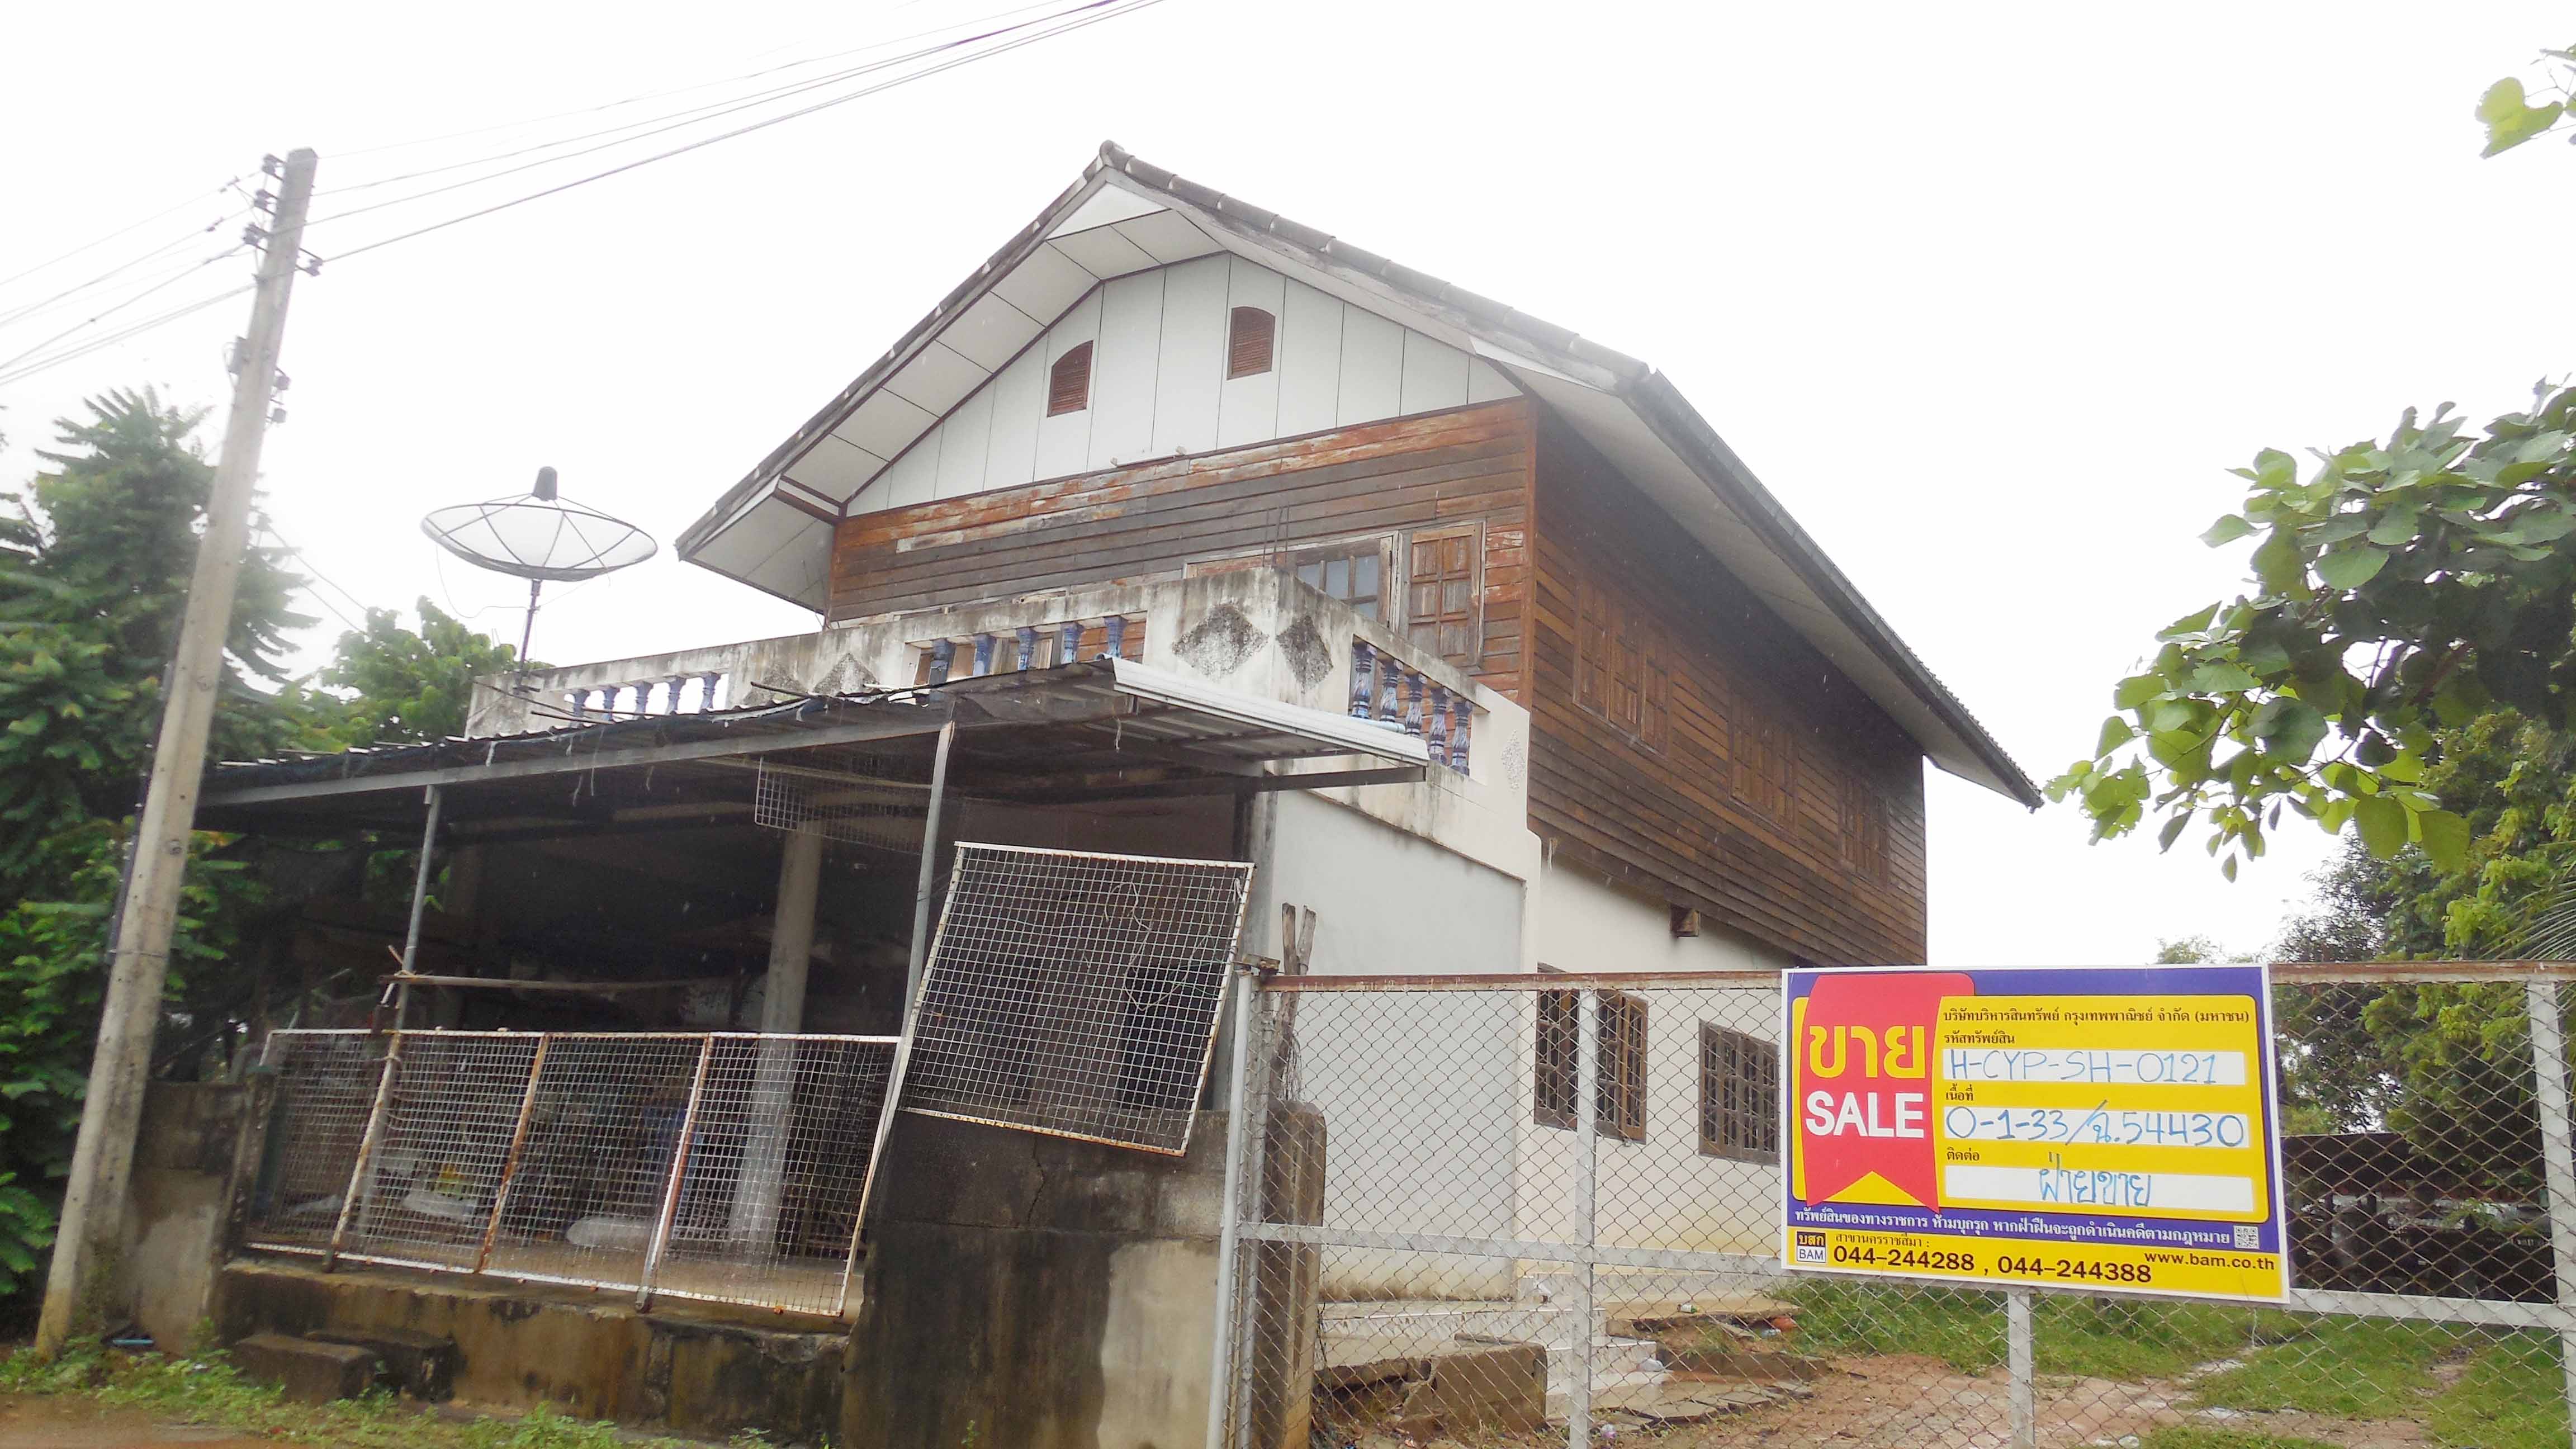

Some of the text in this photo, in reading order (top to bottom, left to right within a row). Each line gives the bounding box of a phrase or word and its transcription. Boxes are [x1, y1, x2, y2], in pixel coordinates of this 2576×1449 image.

[1943, 1007, 2250, 1026] บริษัทบริหารสินทรัพย์ กรุงเทพพาณิชย์ จำกัด (มหาชน)
[1944, 1029, 2015, 1044] รหัสทรัพย์สิน
[1808, 1025, 1926, 1079] ขาย
[1950, 1049, 2217, 1085] H-CYP-SH-0121
[1945, 1083, 1974, 1102] เนื้อที่
[1805, 1090, 1924, 1139] SALE
[1946, 1146, 1980, 1162] ติดต่อ
[1794, 1206, 2230, 1247] ทรัพย์สินของทางราชการ ห้ามบุกรุก หากฝ่าฝืนจะถูกดำเนินคดีตามกฎหมาย
[1798, 1234, 1826, 1246] บสก
[1798, 1249, 1824, 1261] BAM
[1833, 1245, 1974, 1271] 044-244288
[1997, 1256, 2152, 1283] 044-244388
[2144, 1251, 2275, 1270] www.bam.co.th
